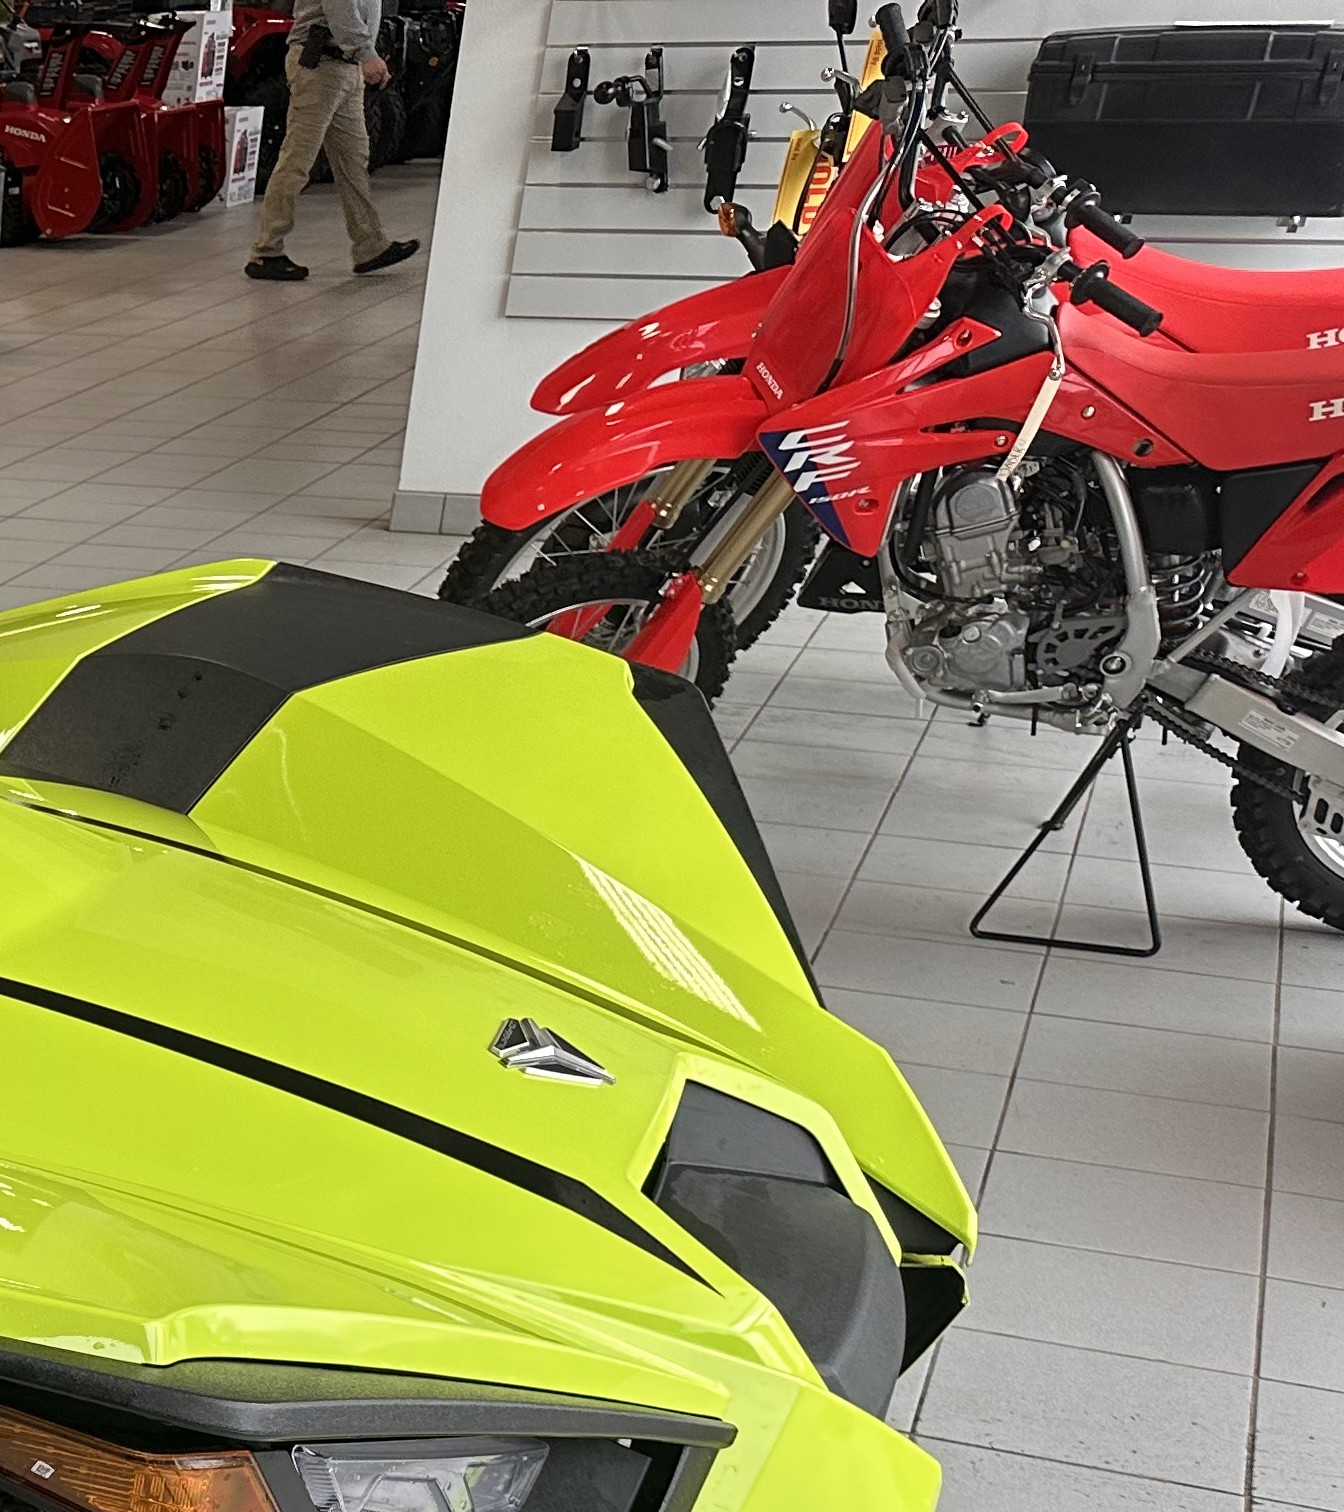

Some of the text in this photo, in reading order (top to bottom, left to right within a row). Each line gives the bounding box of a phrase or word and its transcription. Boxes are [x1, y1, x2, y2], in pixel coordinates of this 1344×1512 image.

[4, 124, 48, 144] HONDA
[1306, 328, 1344, 350] H
[756, 361, 783, 400] HONDA
